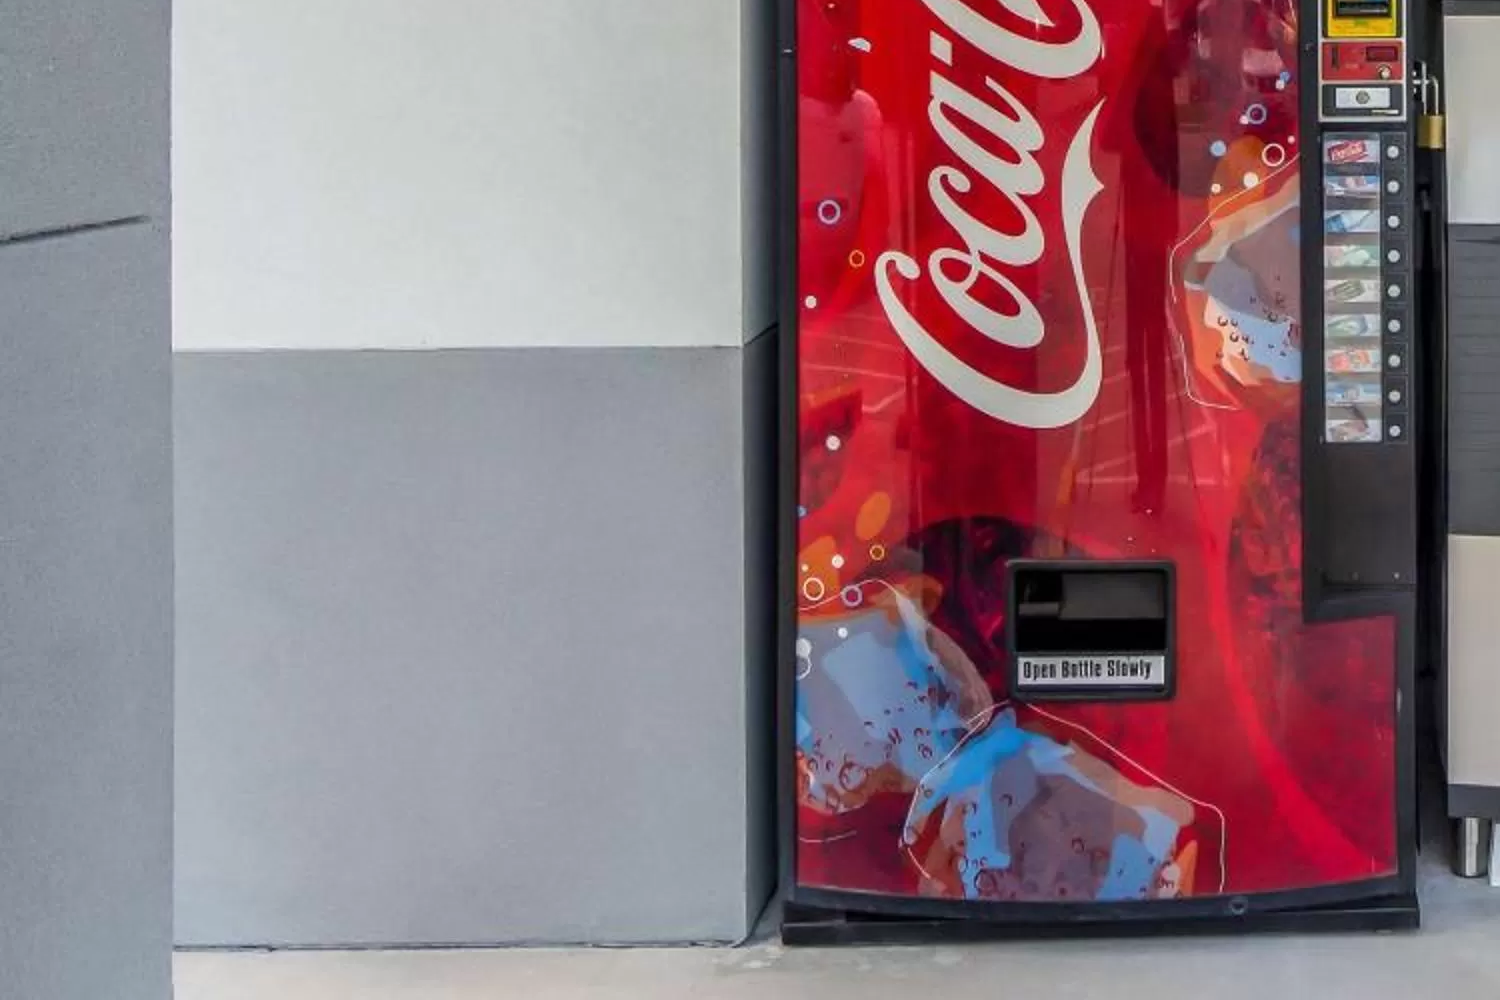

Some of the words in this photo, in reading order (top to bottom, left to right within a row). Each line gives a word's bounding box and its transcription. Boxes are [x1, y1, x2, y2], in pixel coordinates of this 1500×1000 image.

[1023, 661, 1057, 681] Open
[1061, 660, 1102, 679] Bottle
[1107, 659, 1153, 680] Slowly
